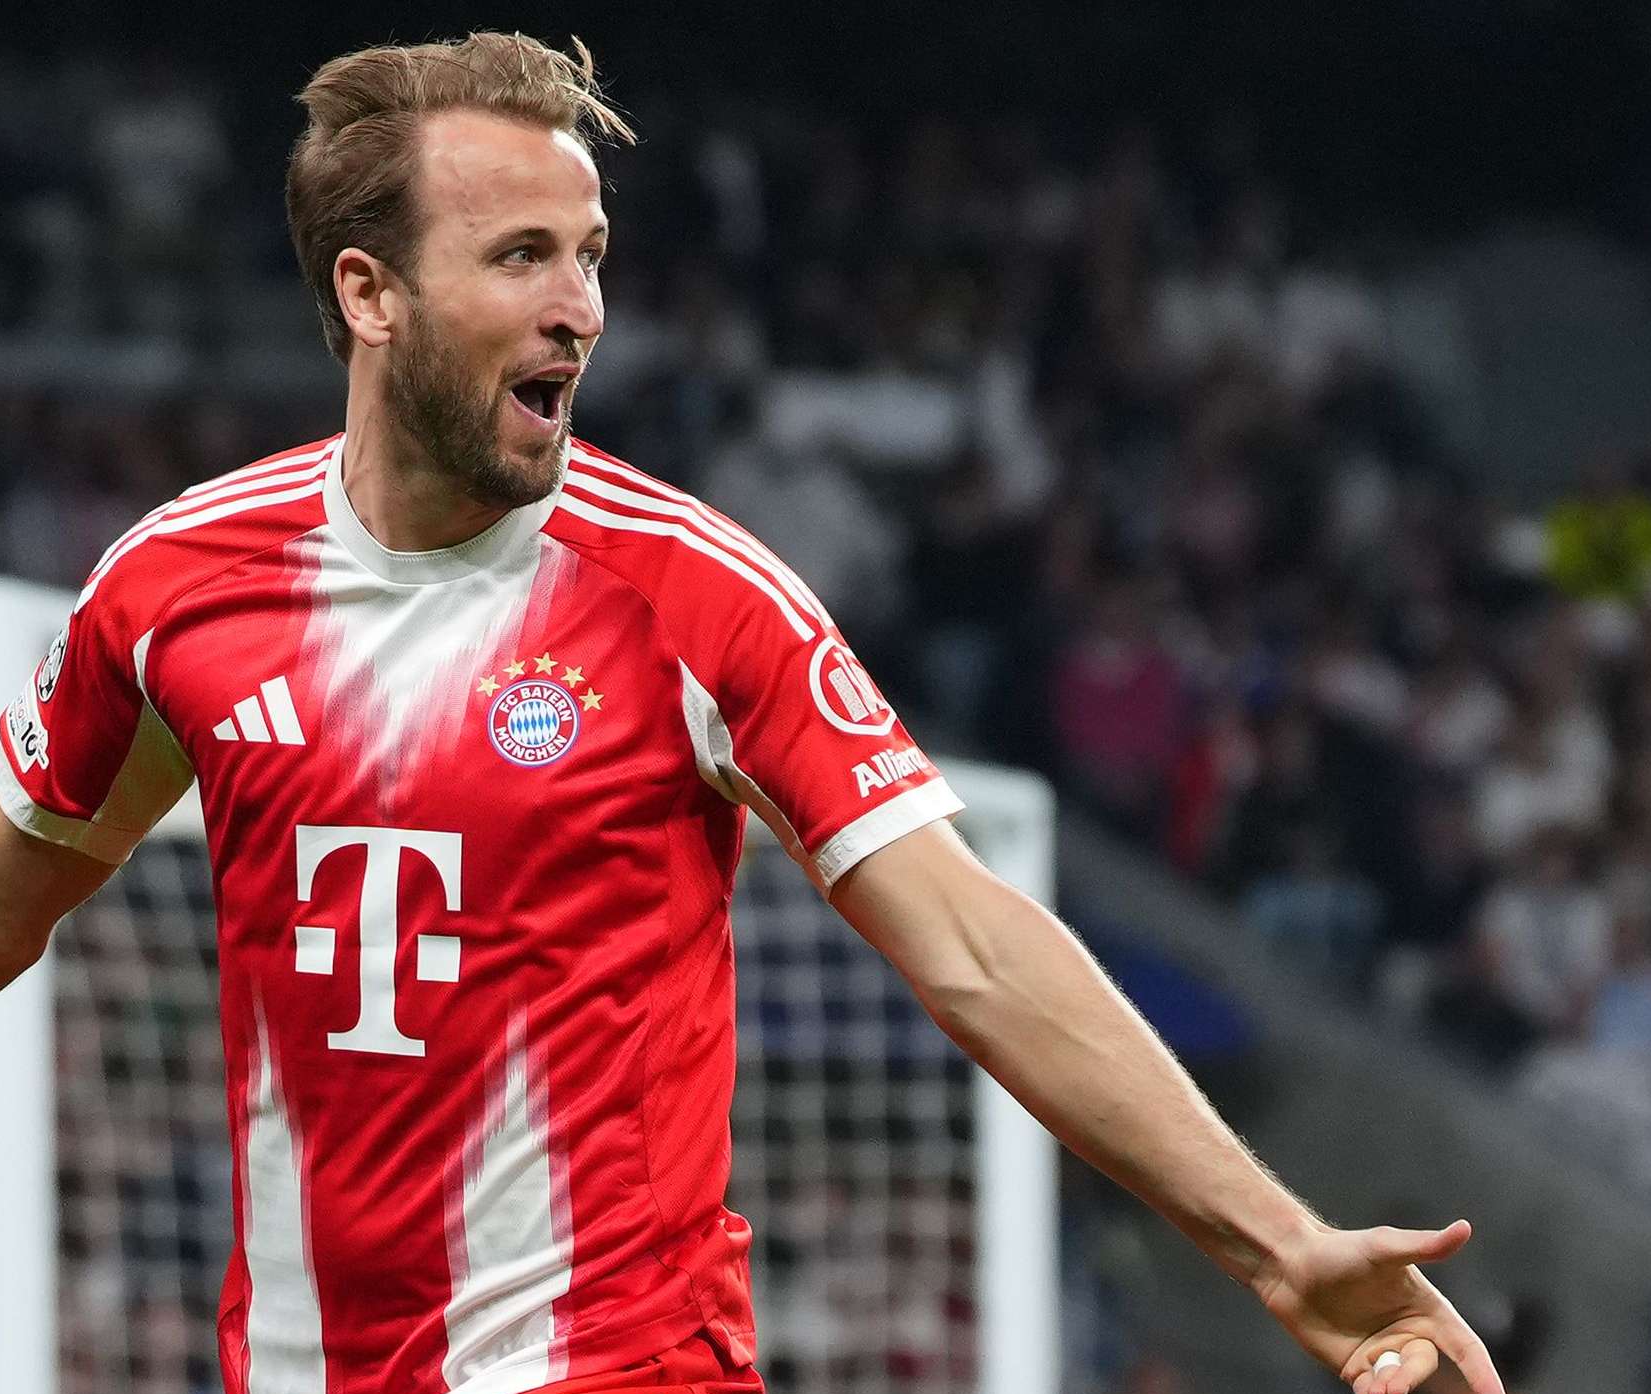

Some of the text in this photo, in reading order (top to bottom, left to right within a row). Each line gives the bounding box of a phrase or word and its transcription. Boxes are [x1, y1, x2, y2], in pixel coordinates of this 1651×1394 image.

[499, 686, 573, 721] FC BAYERN
[851, 748, 930, 798] Allian
[296, 826, 462, 1057] T
